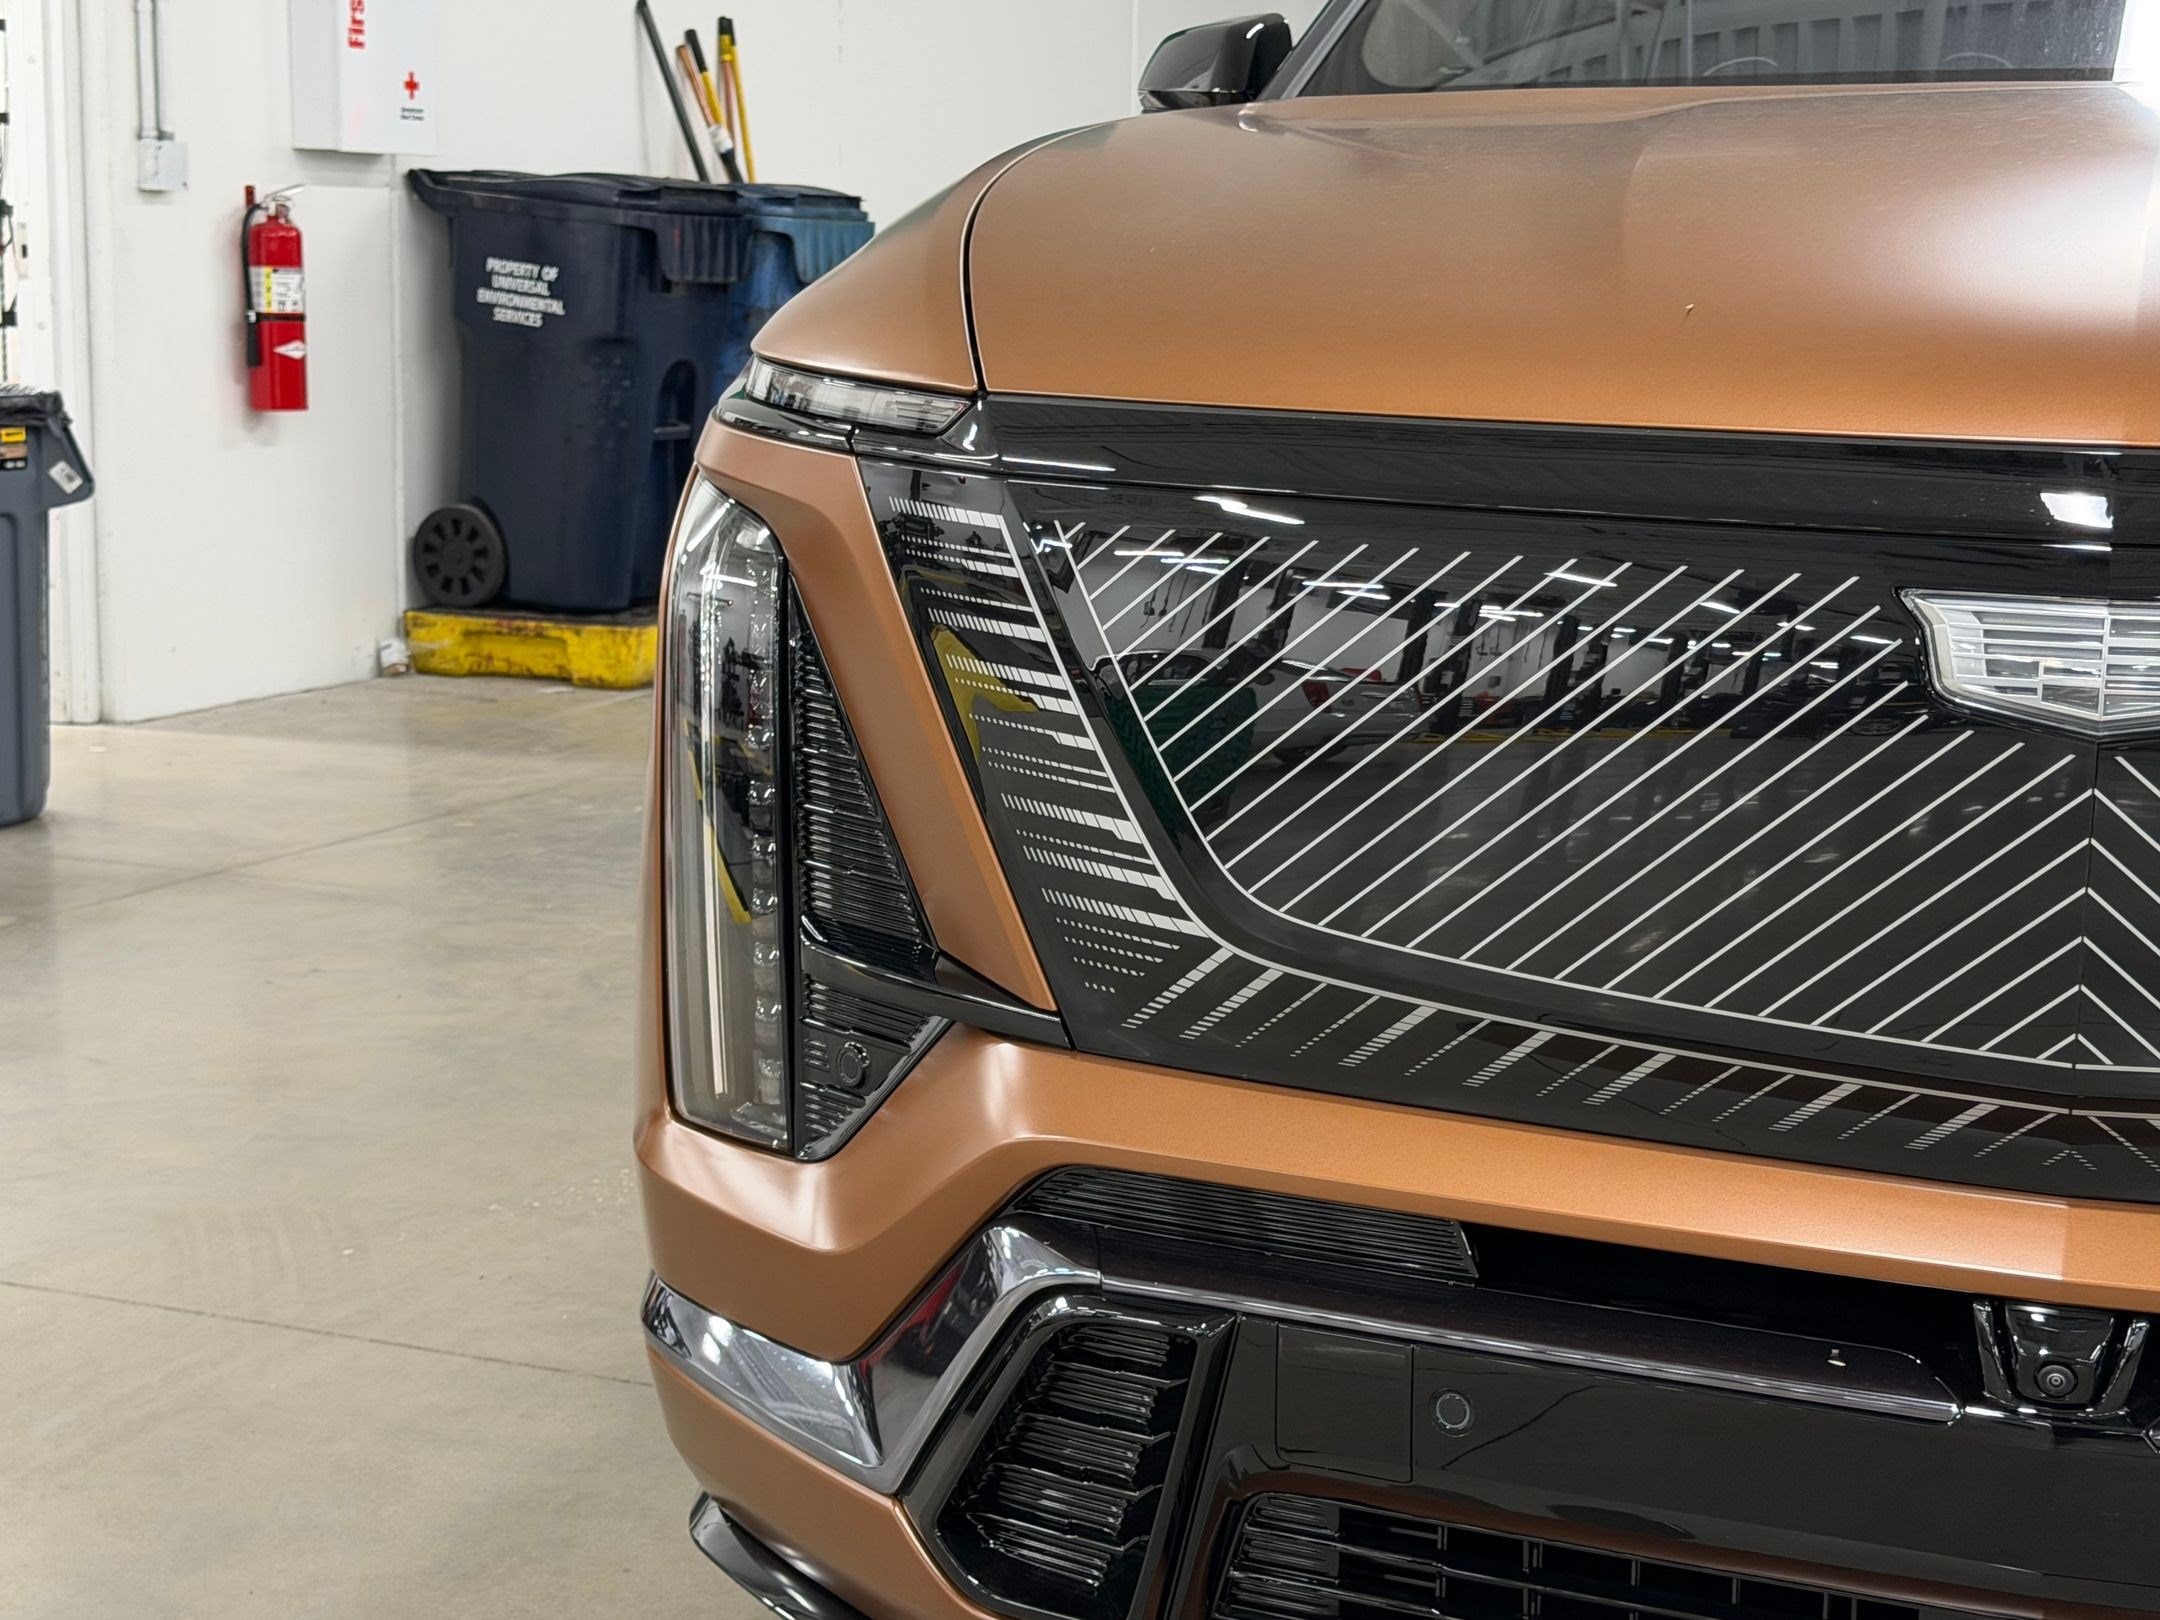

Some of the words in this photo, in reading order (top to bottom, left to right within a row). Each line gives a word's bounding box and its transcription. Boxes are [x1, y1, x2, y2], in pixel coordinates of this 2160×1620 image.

[485, 257, 540, 279] PROPERTY
[541, 265, 560, 282] OF
[491, 274, 551, 296] UNIVERSAL
[476, 287, 566, 315] ENVIRONMENTAL
[493, 306, 543, 328] SERVICES
